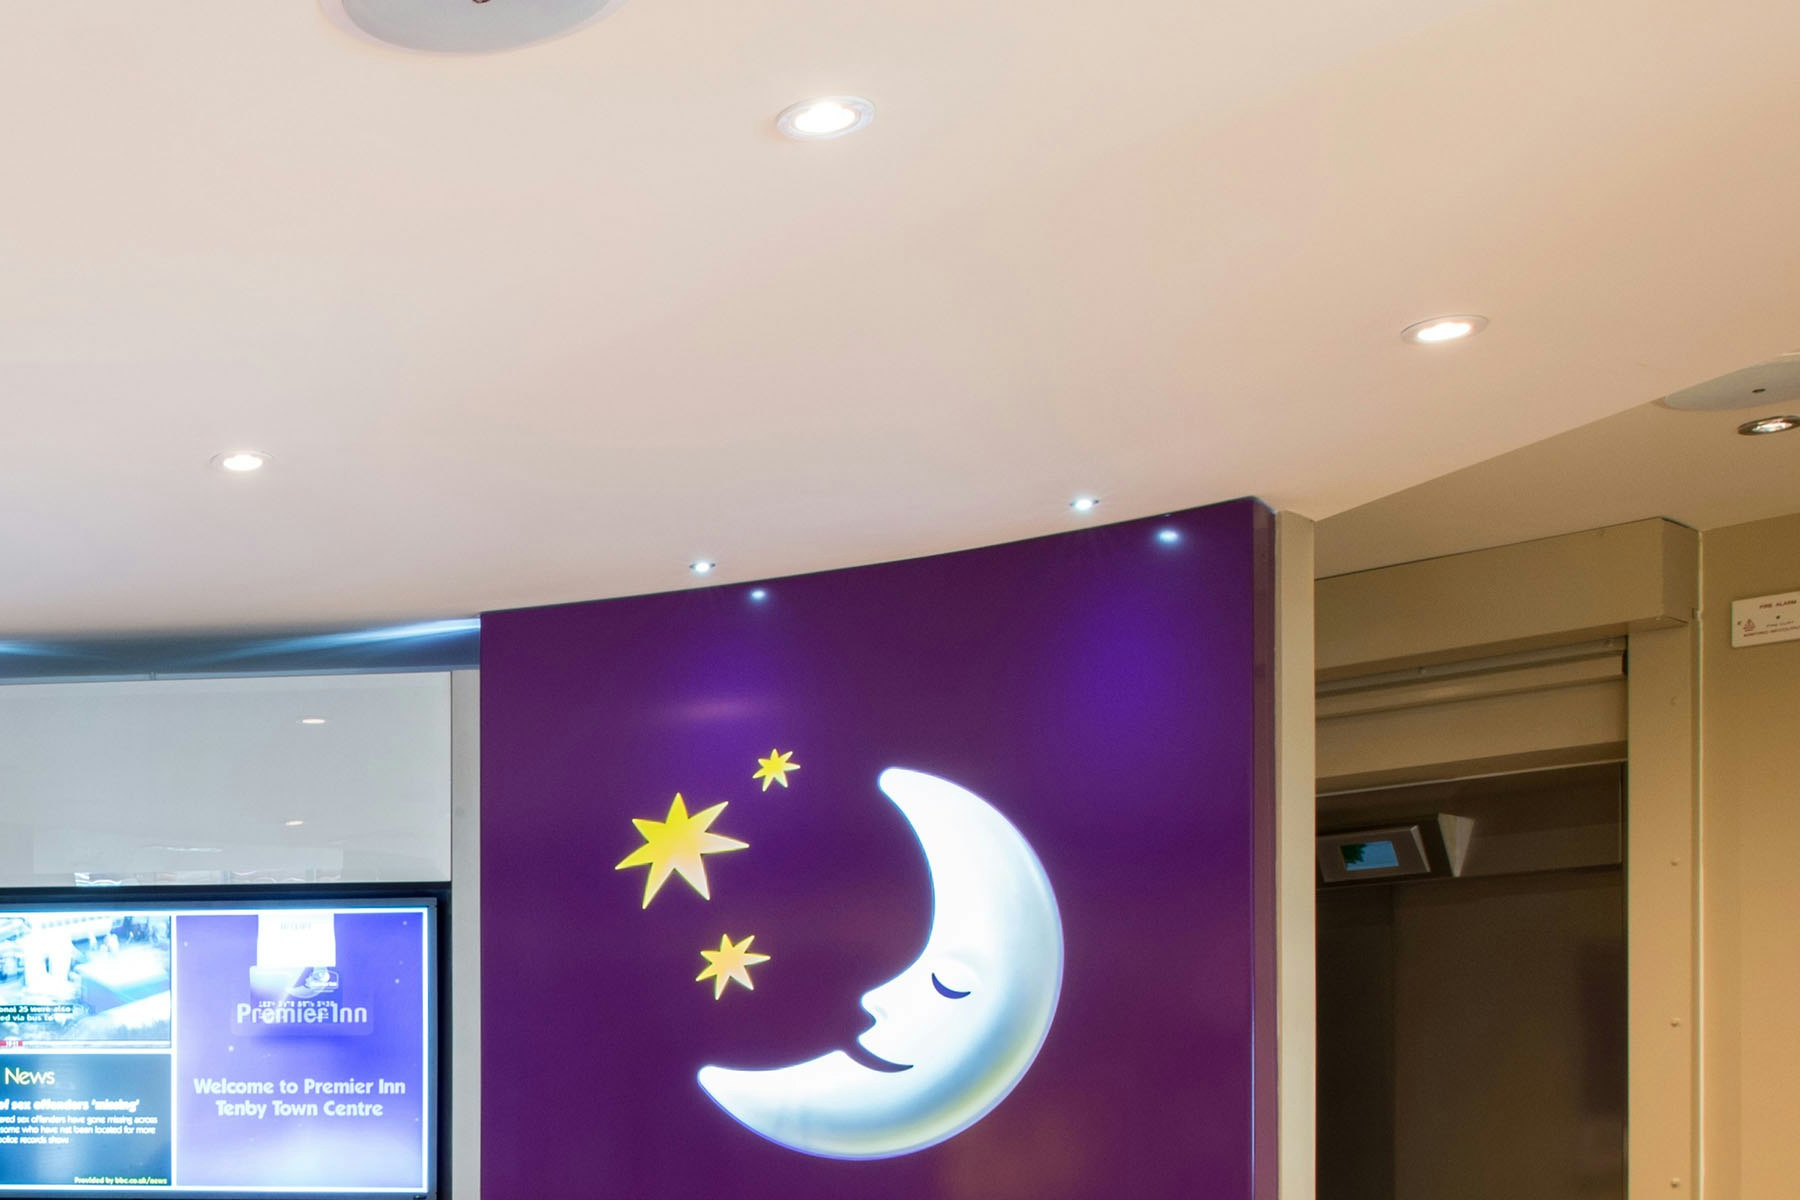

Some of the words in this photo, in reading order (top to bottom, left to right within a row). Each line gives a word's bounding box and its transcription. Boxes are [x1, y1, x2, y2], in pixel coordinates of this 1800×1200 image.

[52, 1005, 71, 1013] also
[236, 1002, 329, 1024] Premier
[332, 1002, 368, 1023] Inn
[12, 1014, 25, 1022] via
[27, 1014, 42, 1022] bus
[4, 1067, 55, 1085] News
[193, 1078, 274, 1095] Welcome
[279, 1080, 298, 1095] to
[303, 1078, 374, 1095] Premier
[378, 1078, 406, 1095] Inn
[11, 1101, 31, 1110] sex
[33, 1098, 89, 1110] offenders
[215, 1100, 267, 1120] Tenby
[271, 1100, 318, 1117] Town
[323, 1100, 384, 1117] Centre
[31, 1114, 66, 1124] offenders
[67, 1115, 85, 1124] have
[86, 1117, 106, 1125] gone
[107, 1115, 133, 1125] missing
[21, 1126, 39, 1134] who
[40, 1126, 58, 1134] have
[73, 1126, 93, 1134] been
[95, 1126, 123, 1134] located
[123, 1126, 135, 1134] for
[19, 1135, 47, 1144] records
[48, 1136, 70, 1144] show
[105, 1177, 114, 1185] by
